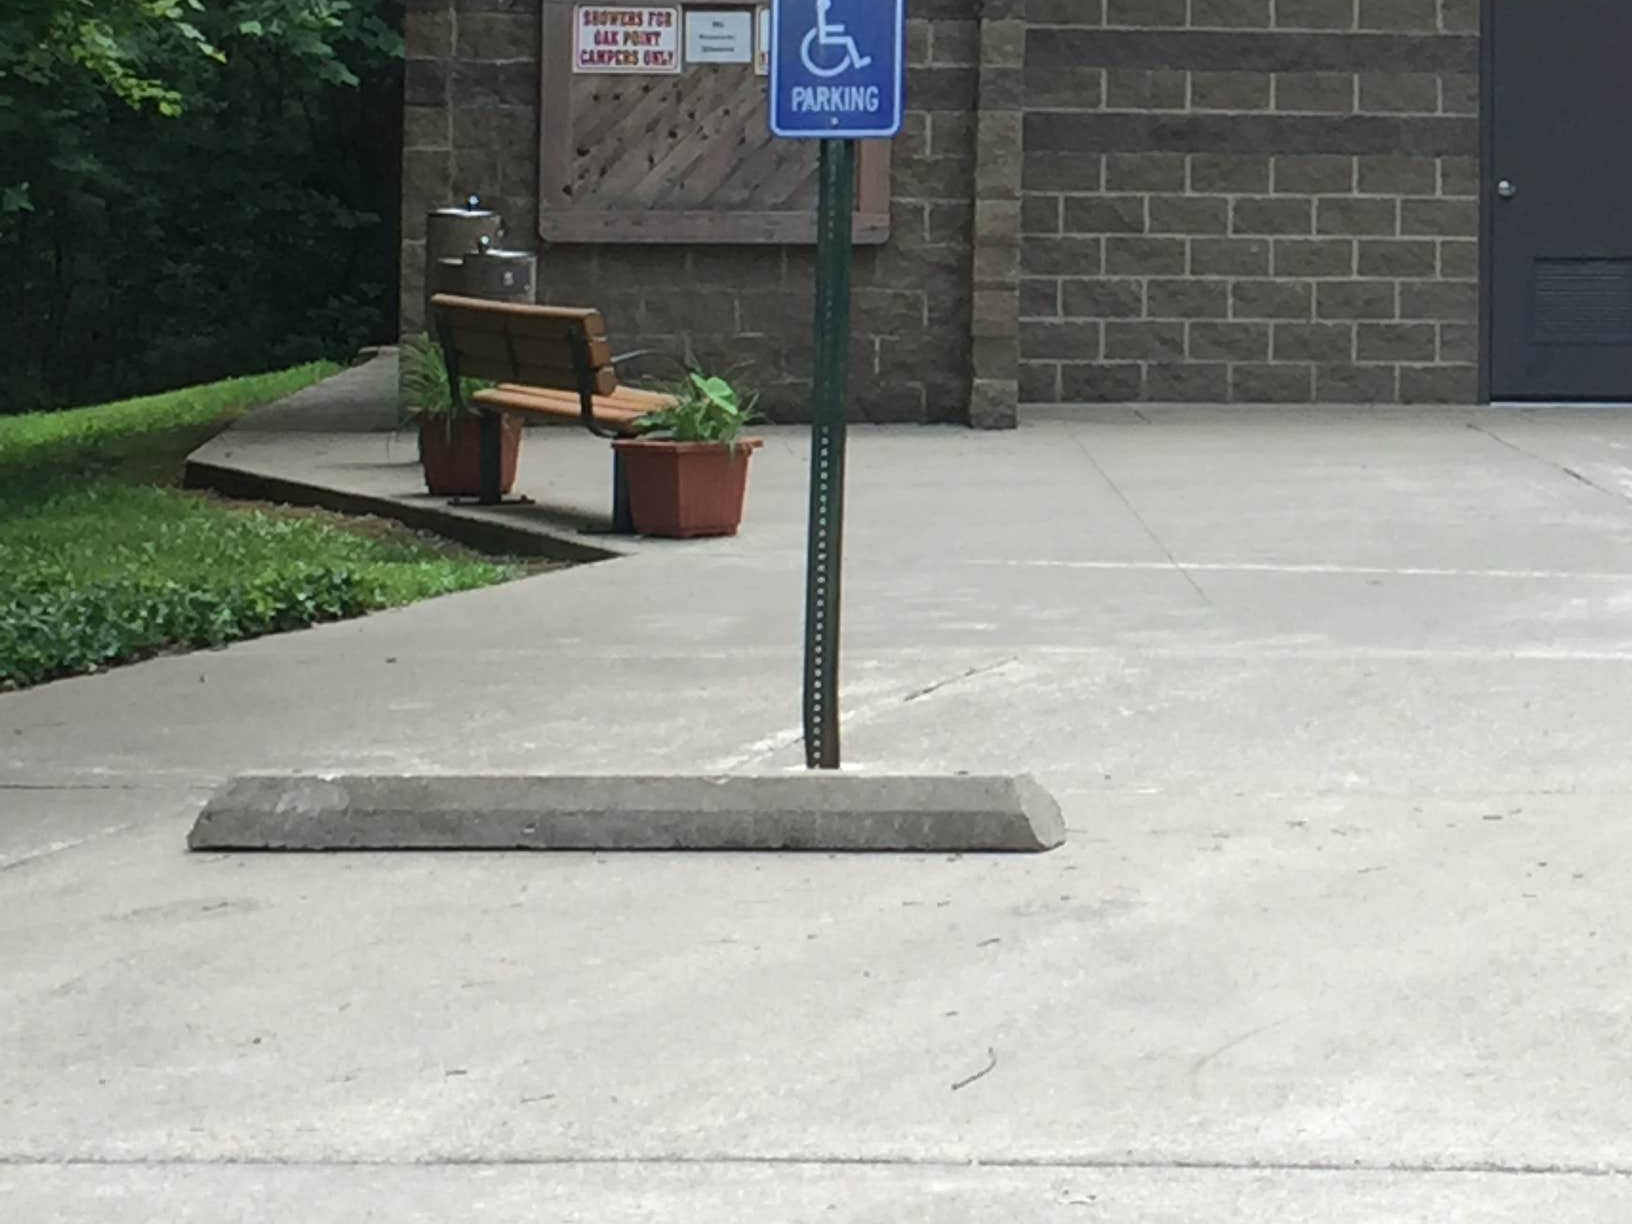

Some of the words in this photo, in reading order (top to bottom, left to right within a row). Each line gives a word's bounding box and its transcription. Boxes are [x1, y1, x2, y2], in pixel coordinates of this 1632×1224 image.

[583, 9, 643, 26] SHOWERS
[648, 10, 673, 27] FOR
[594, 30, 618, 46] OAK
[623, 30, 661, 46] POINT
[580, 49, 639, 66] CAMPERS
[792, 86, 879, 112] PARKING
